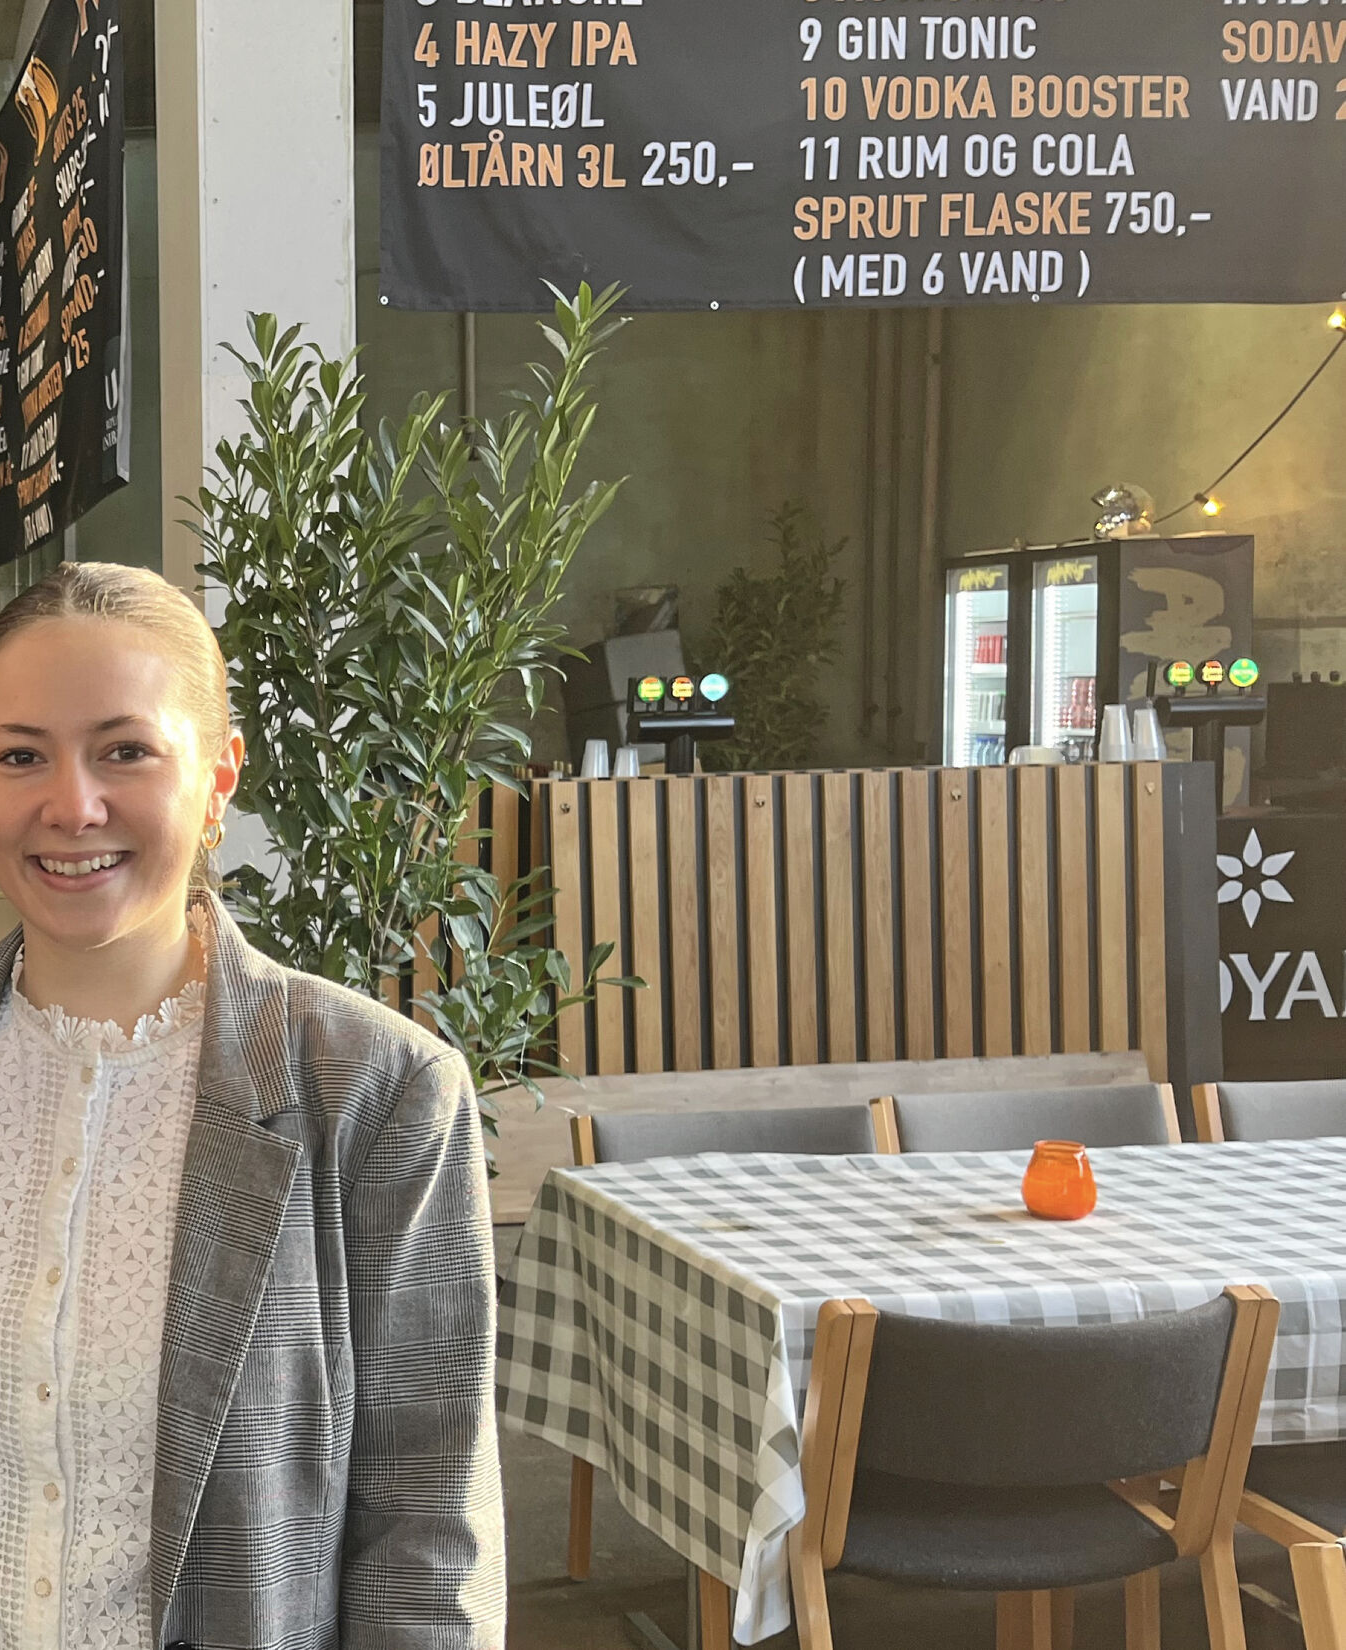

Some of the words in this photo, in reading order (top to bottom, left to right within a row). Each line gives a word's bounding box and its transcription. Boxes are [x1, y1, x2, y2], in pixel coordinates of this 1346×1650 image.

[414, 22, 440, 68] 4
[455, 20, 558, 69] HAZY
[571, 20, 638, 67] IPA
[799, 17, 822, 62] 9
[838, 16, 907, 61] GIN
[919, 16, 1037, 61] TONIC
[1221, 19, 1346, 64] SODAV
[417, 83, 437, 128] 5
[449, 81, 605, 130] JULEØL
[800, 76, 847, 121] 10
[861, 75, 997, 121] VODKA
[1010, 74, 1190, 119] BOOSTER
[1220, 78, 1319, 122] VAND
[417, 129, 564, 188] ØLTÅRN
[577, 143, 627, 188] 3L
[799, 136, 840, 181] 11
[858, 134, 948, 180] RUM
[964, 133, 1017, 178] OG
[1032, 133, 1135, 177] COLA
[793, 194, 928, 241] SPRUT
[940, 191, 1092, 237] FLASKE
[821, 253, 907, 298] MED
[922, 252, 944, 296] 6
[959, 250, 1064, 295] VAND
[1219, 950, 1346, 1021] YA
